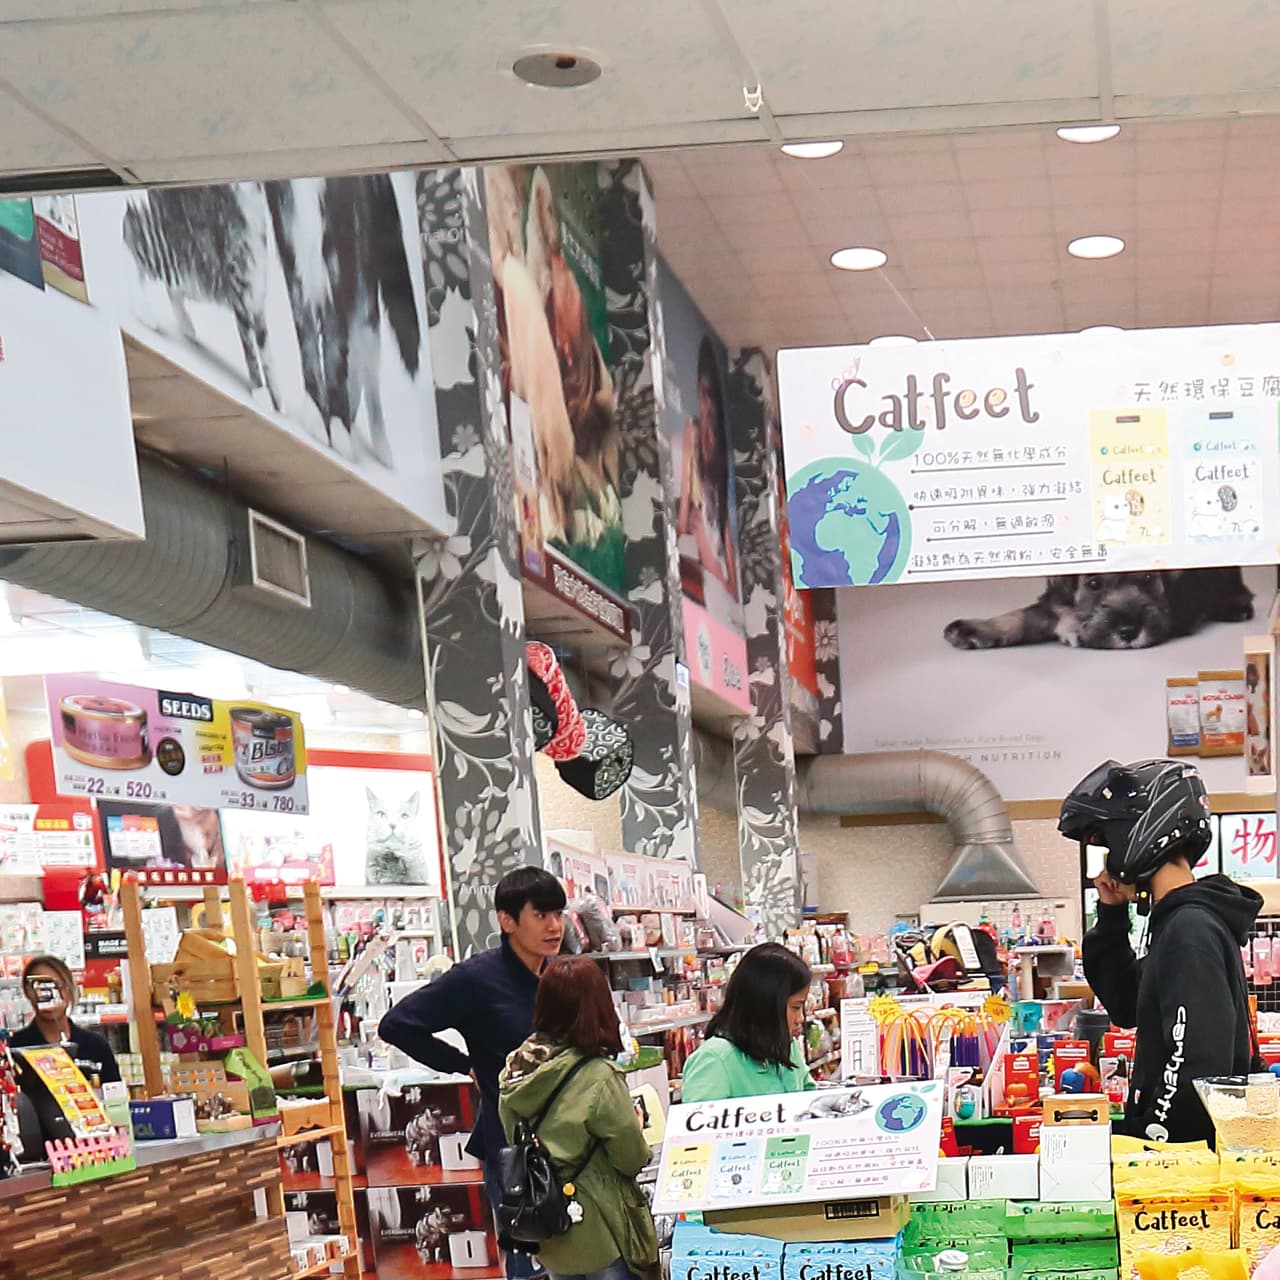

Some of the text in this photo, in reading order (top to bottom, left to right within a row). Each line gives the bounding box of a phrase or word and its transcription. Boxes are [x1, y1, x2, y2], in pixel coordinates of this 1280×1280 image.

[833, 366, 1041, 435] Catfeet
[161, 698, 212, 719] SEEDS
[980, 751, 1063, 762] NUTRITION
[86, 777, 153, 798] 22 520
[239, 792, 295, 812] 33 780
[685, 1103, 786, 1132] Catfeet
[1134, 1209, 1210, 1232] Catfeet
